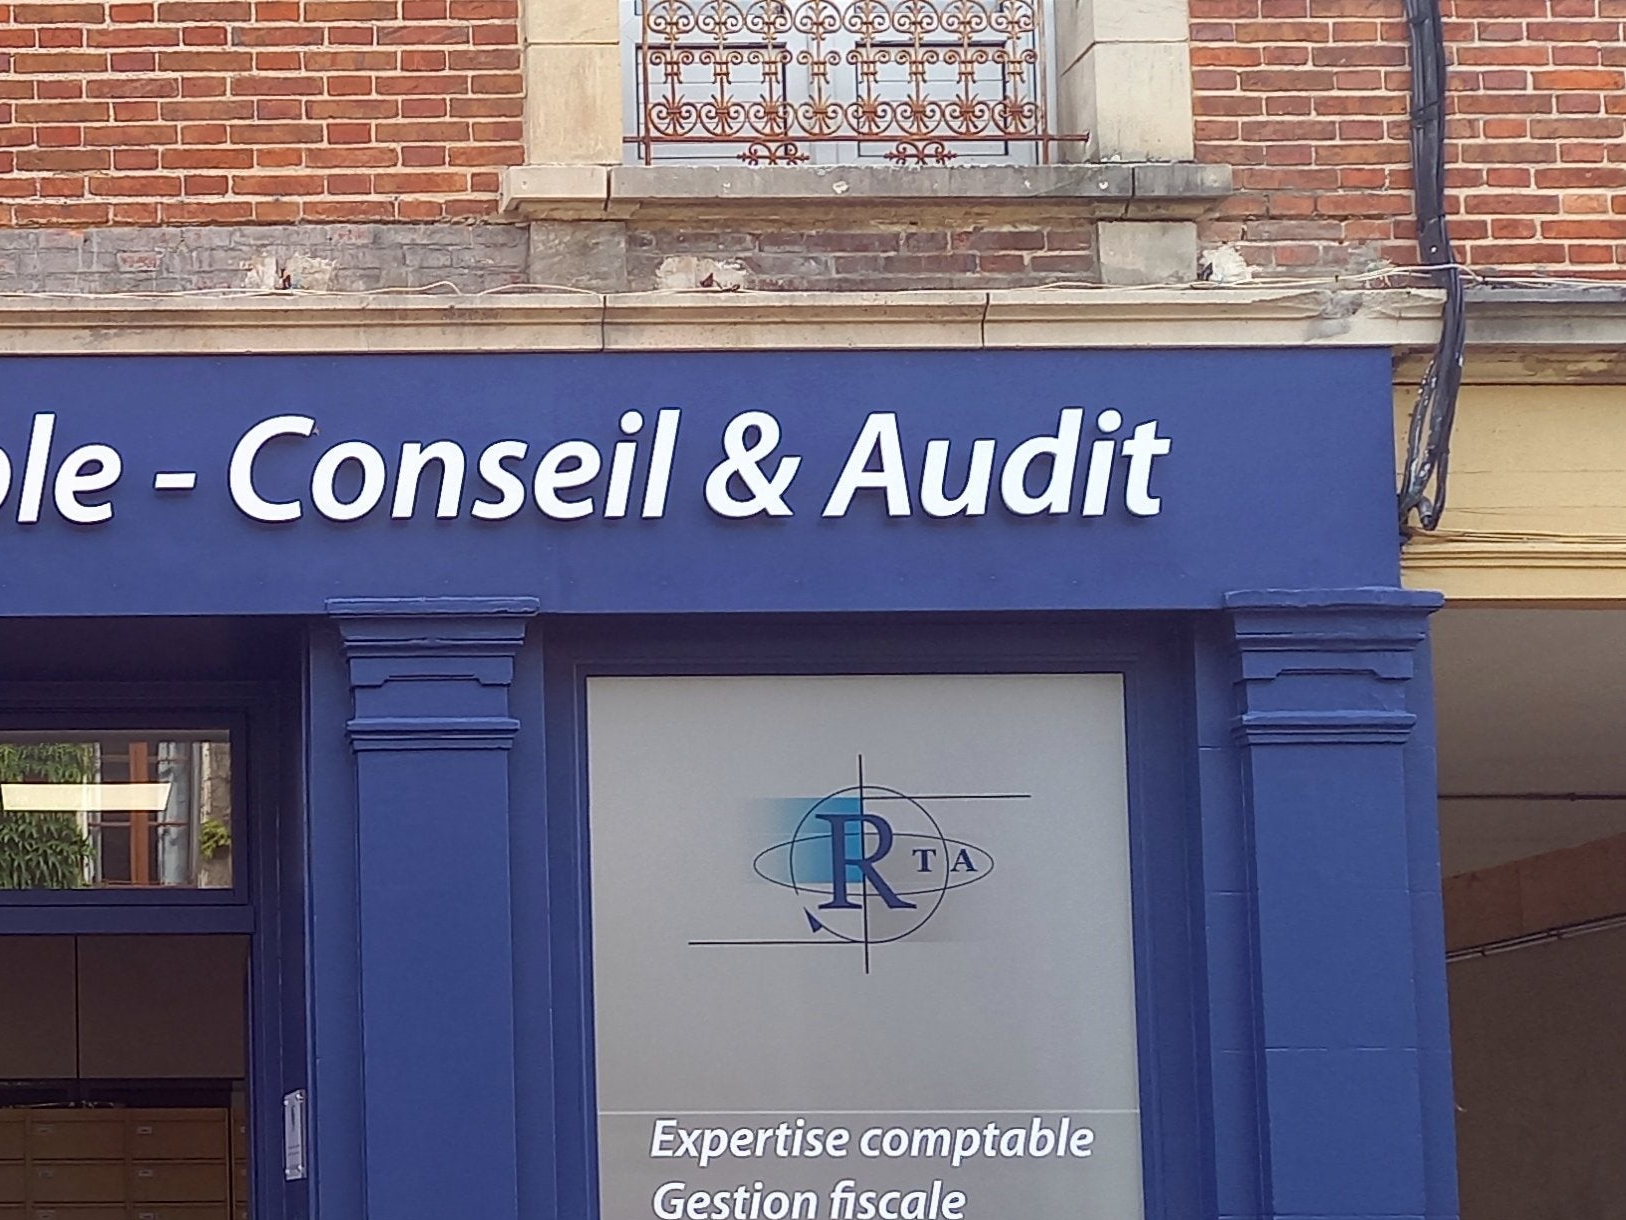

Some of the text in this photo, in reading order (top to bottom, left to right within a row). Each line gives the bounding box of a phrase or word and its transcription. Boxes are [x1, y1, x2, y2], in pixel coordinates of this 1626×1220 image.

[155, 472, 196, 489] -
[229, 409, 681, 521] Conseil
[705, 411, 803, 518] &
[822, 408, 1171, 519] Audit
[650, 1116, 1095, 1168] Expertise comptable
[652, 1179, 967, 1220] Gestion fiscale
